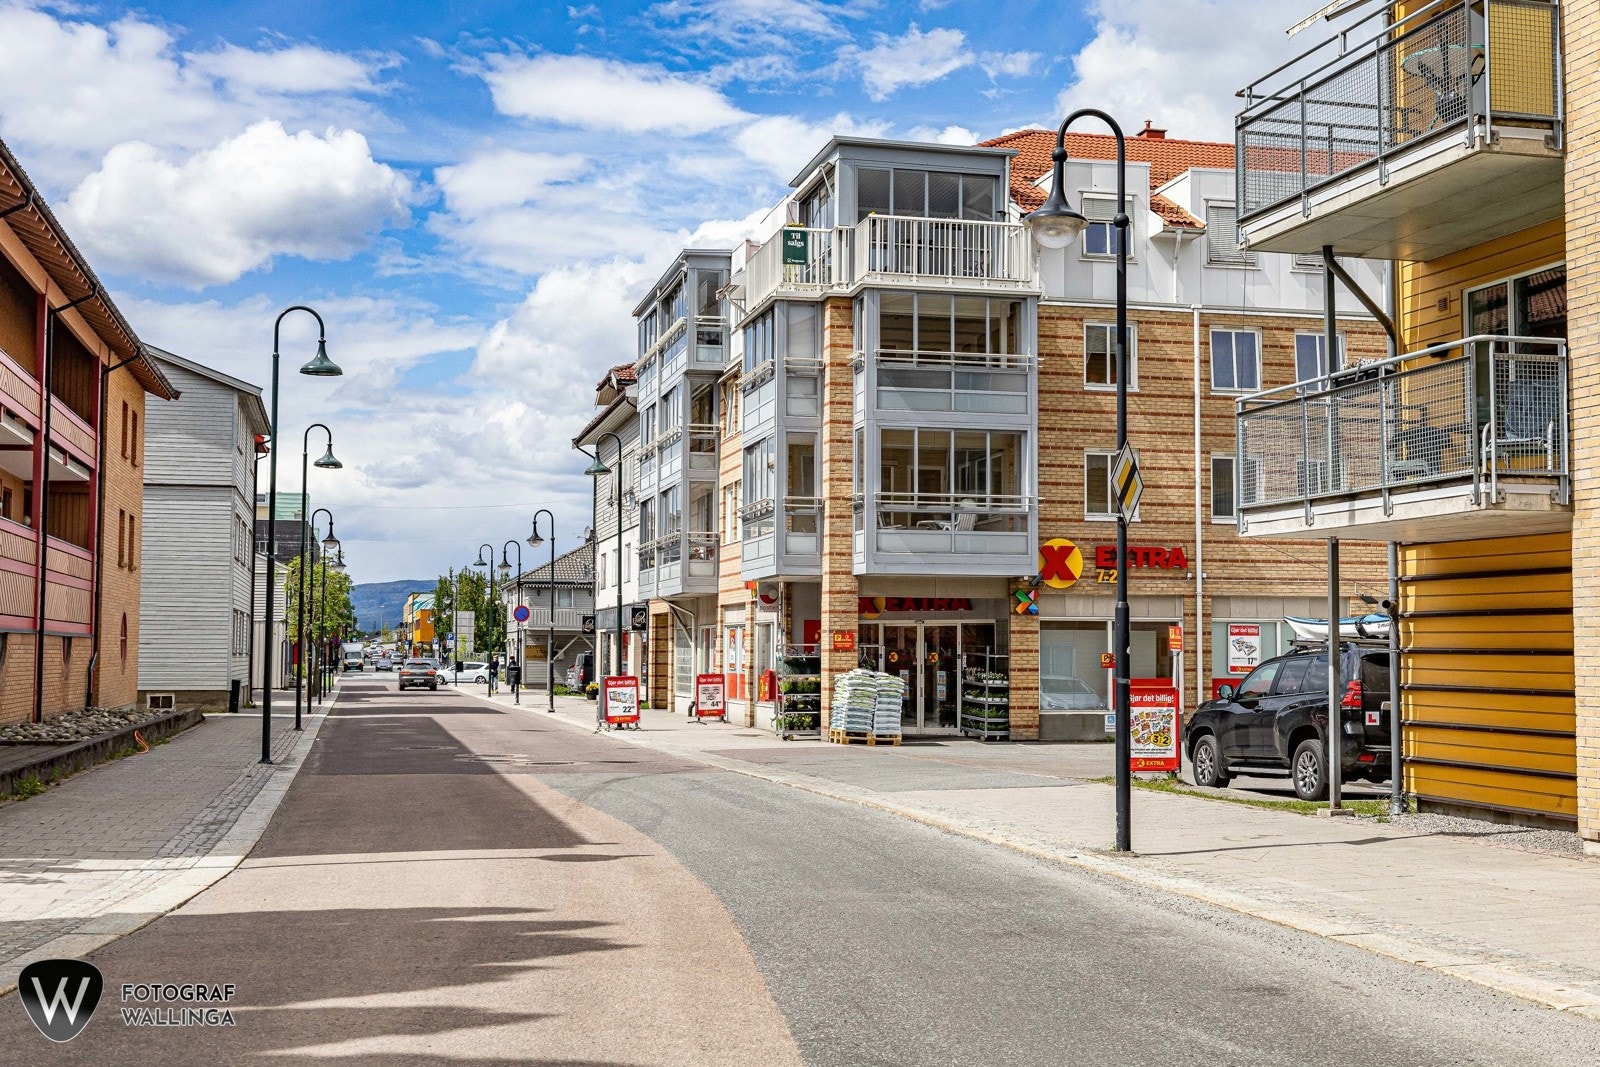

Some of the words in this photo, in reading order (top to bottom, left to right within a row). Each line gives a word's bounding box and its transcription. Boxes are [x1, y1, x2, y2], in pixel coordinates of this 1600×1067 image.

[787, 240, 805, 248] salgs
[1095, 546, 1189, 569] EXTRA
[1142, 694, 1154, 702] det
[1156, 694, 1174, 703] billig!
